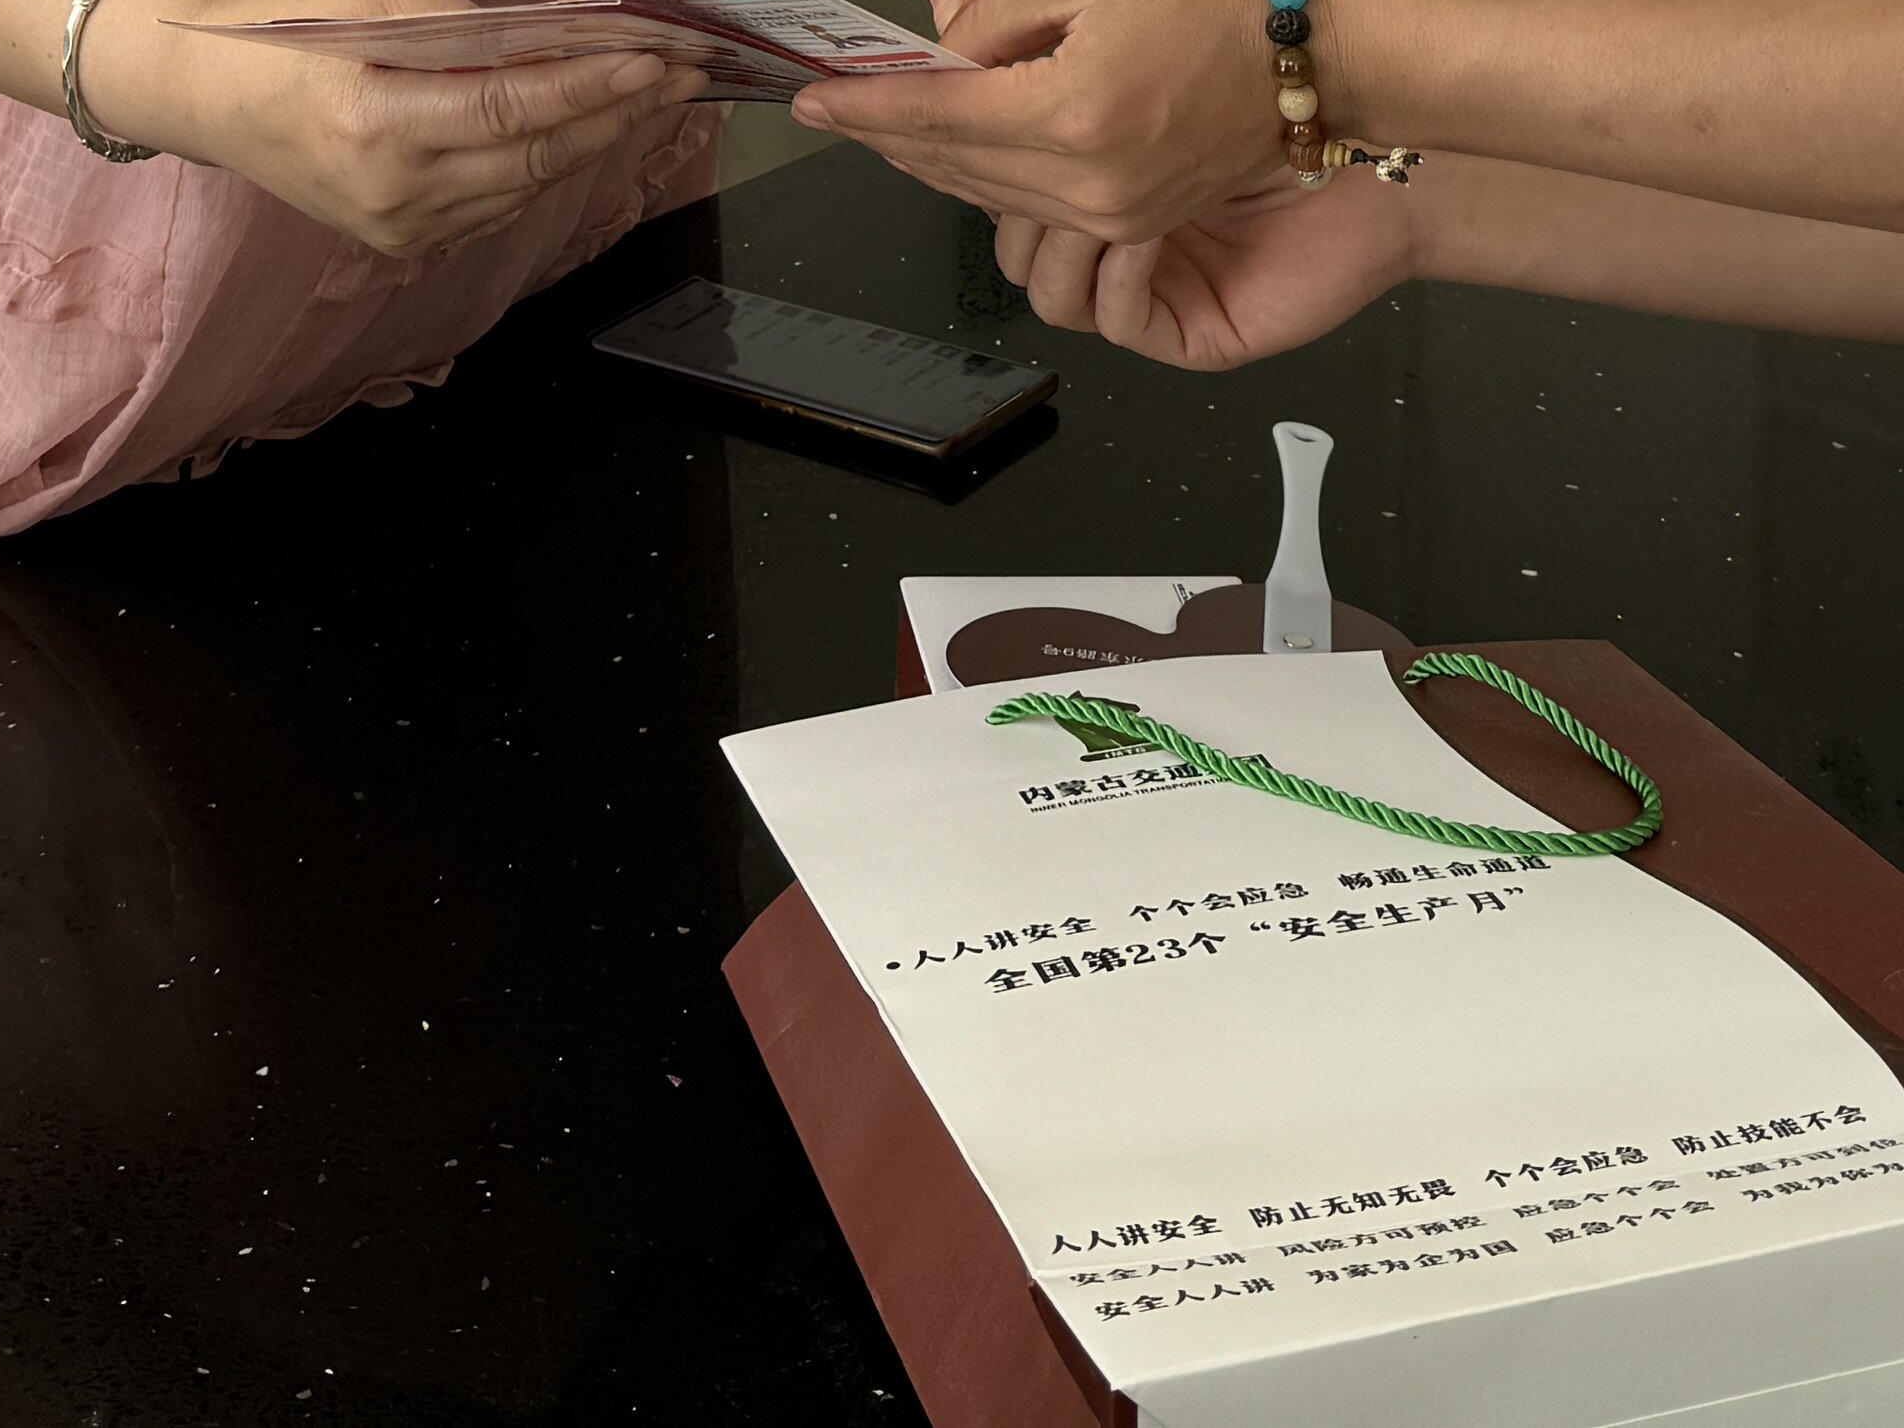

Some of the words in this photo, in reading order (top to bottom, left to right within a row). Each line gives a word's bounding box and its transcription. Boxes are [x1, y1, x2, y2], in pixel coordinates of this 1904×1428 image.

[1019, 754, 1274, 804] 内蒙古交通
[914, 915, 1097, 970] 人人讲安全
[1130, 880, 1310, 923] 个个会应急
[1051, 1214, 1223, 1255] 人人讲安全
[1249, 1178, 1456, 1229] 防止无知无畏
[1484, 1146, 1649, 1189] 个个会应急
[1671, 1104, 1867, 1156] 防止技能不会
[1069, 1252, 1247, 1287] 安全人人讲
[1276, 1215, 1489, 1258] 风险方可预控
[1512, 1179, 1681, 1218] 应急个个会
[1707, 1137, 1904, 1181] 处置方可到位
[1095, 1277, 1275, 1322] 安全人人讲
[1307, 1239, 1518, 1285] 为家为企为国
[1544, 1199, 1715, 1244] 应急个个会
